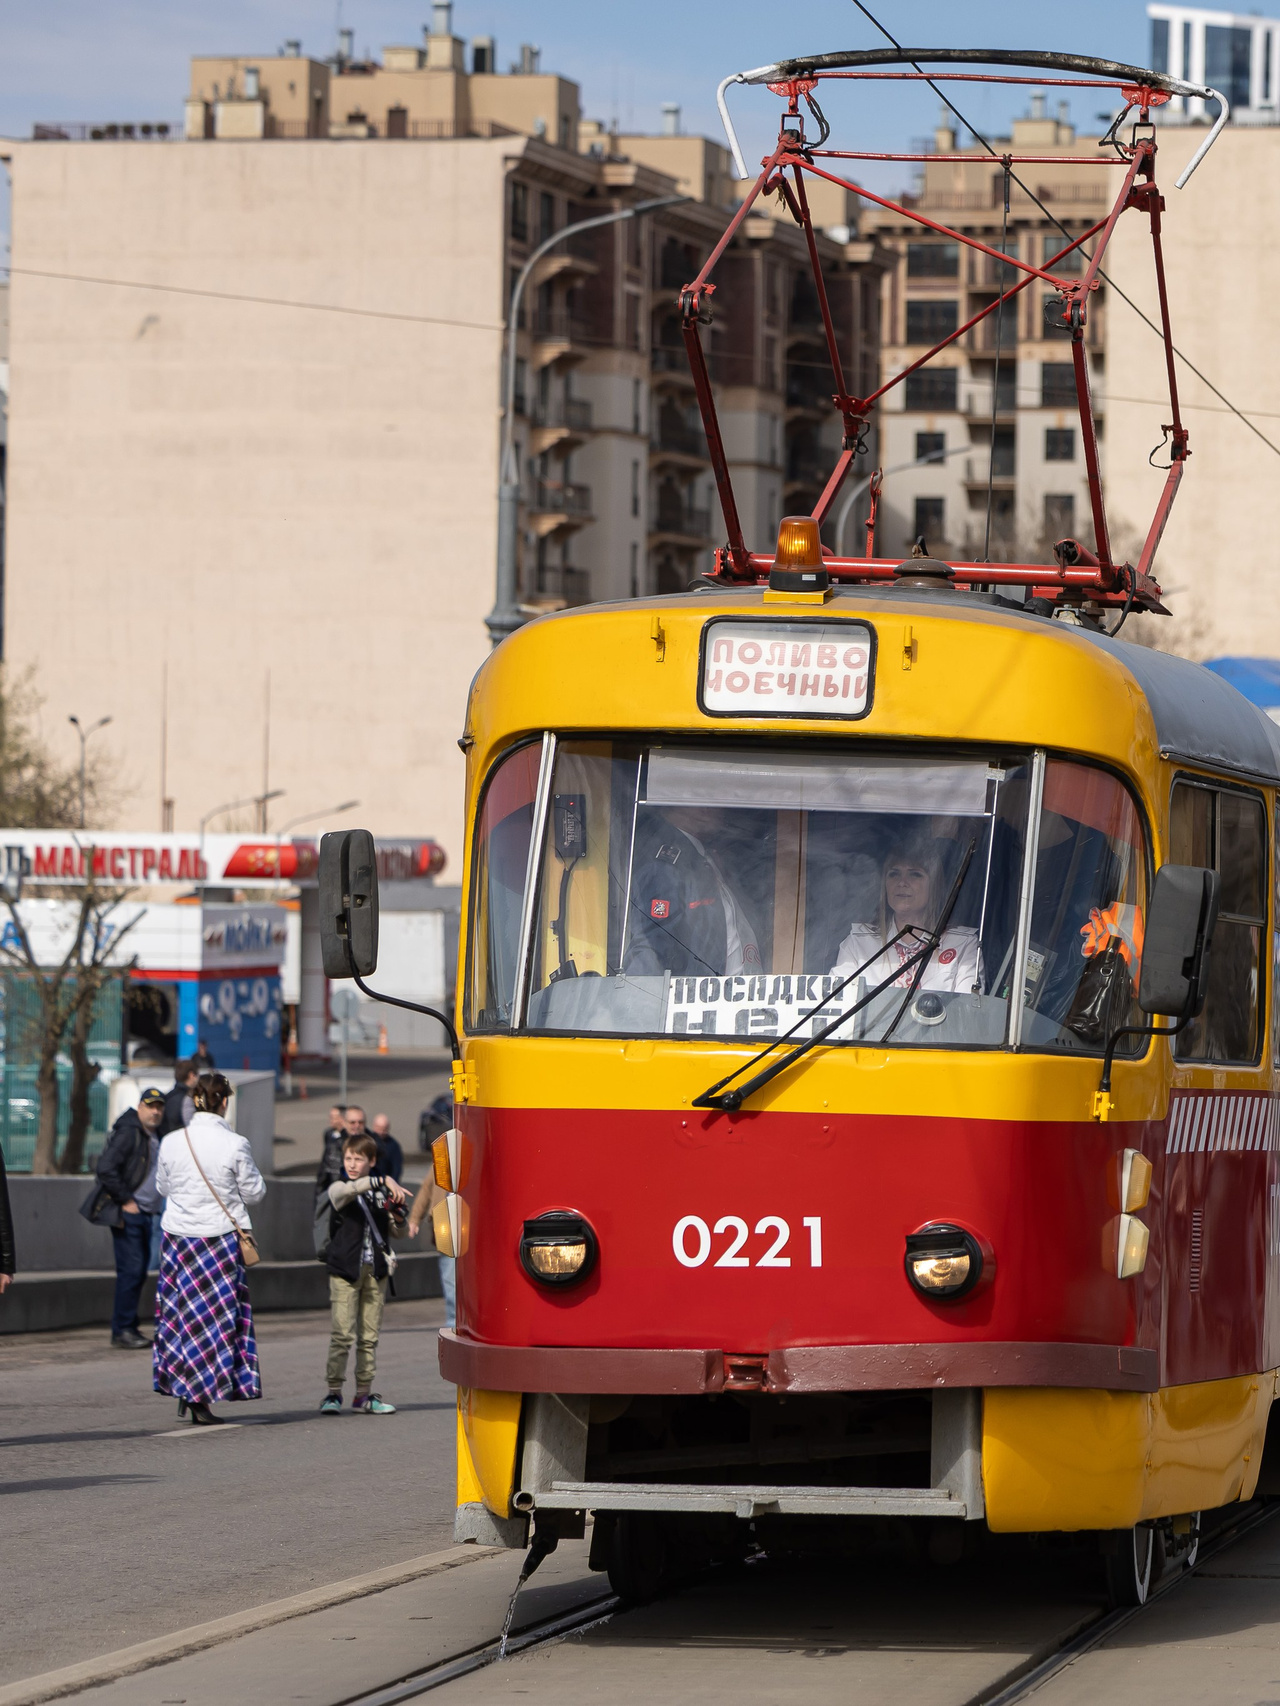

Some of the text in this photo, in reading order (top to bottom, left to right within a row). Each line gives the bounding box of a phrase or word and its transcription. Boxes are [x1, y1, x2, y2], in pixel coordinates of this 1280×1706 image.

[713, 639, 868, 669] ПОЛИВО
[674, 975, 845, 1005] ПОСАДКИ
[672, 1215, 822, 1268] 0221
